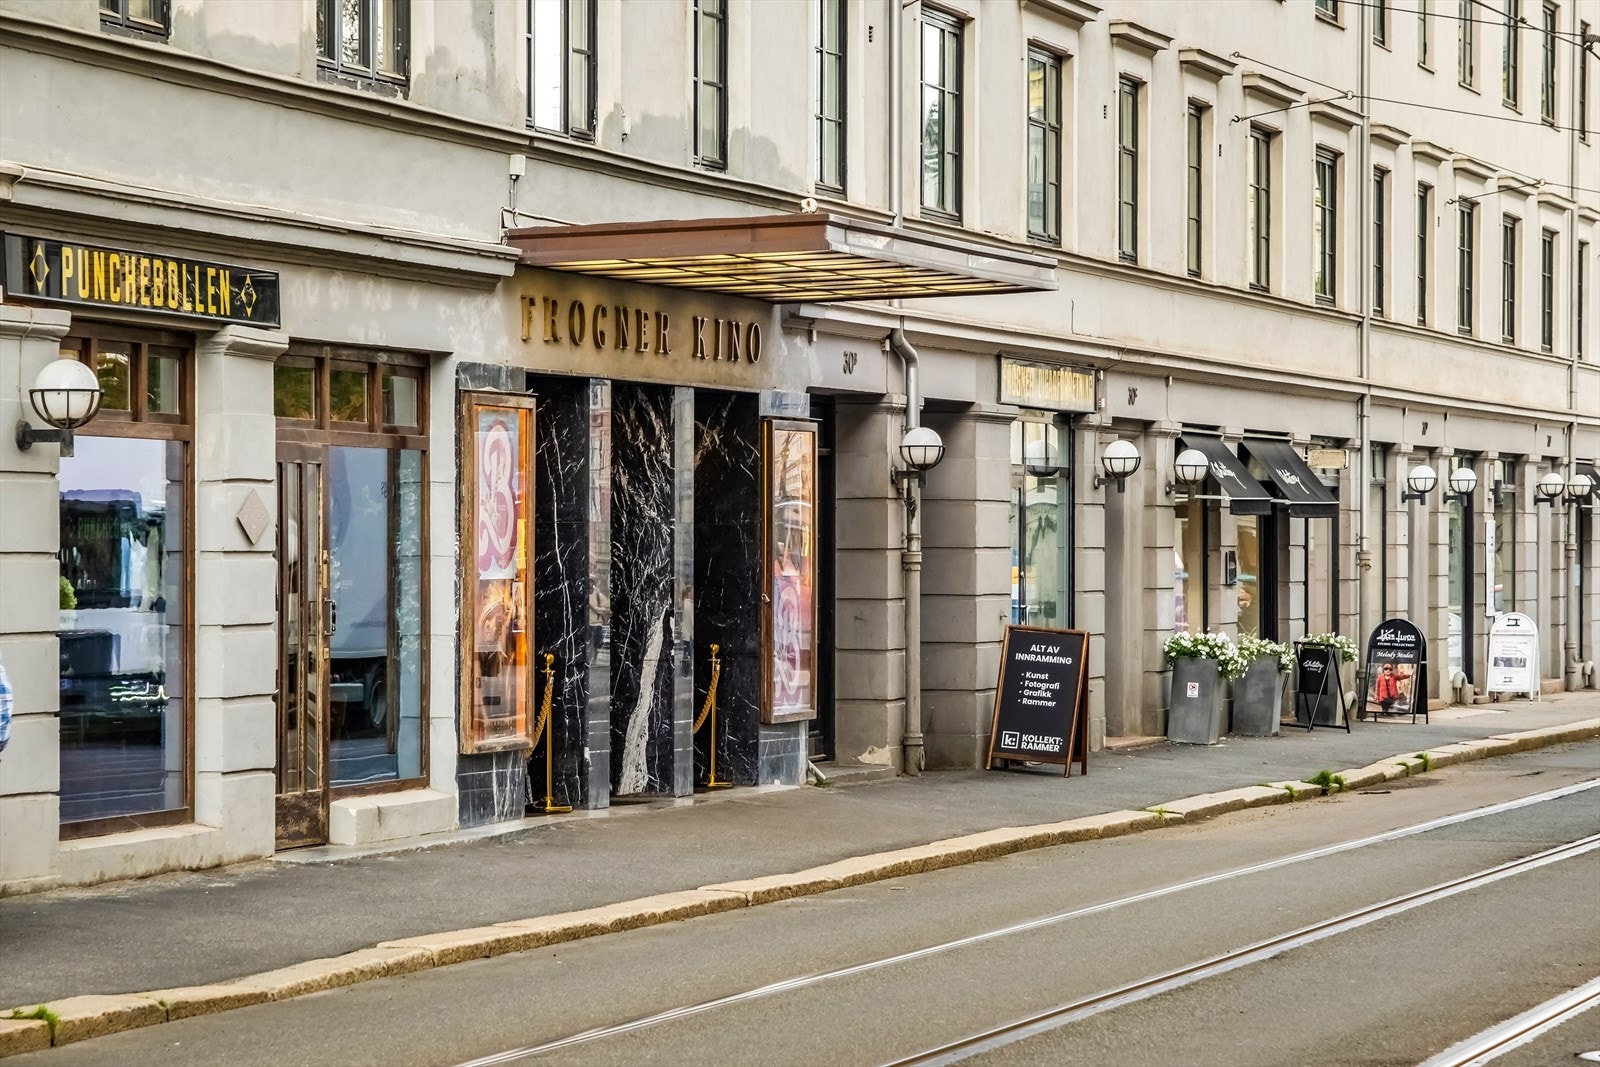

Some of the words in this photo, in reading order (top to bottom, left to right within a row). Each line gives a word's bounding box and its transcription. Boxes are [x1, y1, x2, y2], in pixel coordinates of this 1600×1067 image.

[61, 246, 231, 315] PUNCHEBOLLEN
[520, 294, 672, 354] FROGNER
[692, 315, 762, 364] KINO
[1030, 644, 1046, 652] ALT
[1047, 646, 1060, 654] AV
[1015, 653, 1072, 665] INNRAMMING
[1025, 671, 1049, 680] Kunst
[1024, 680, 1060, 690] Fotografi
[1023, 689, 1052, 698] Grafikk
[1022, 698, 1056, 707] Rammer
[1022, 734, 1063, 745] KOLLEKT:
[1021, 742, 1060, 752] RAMMER
